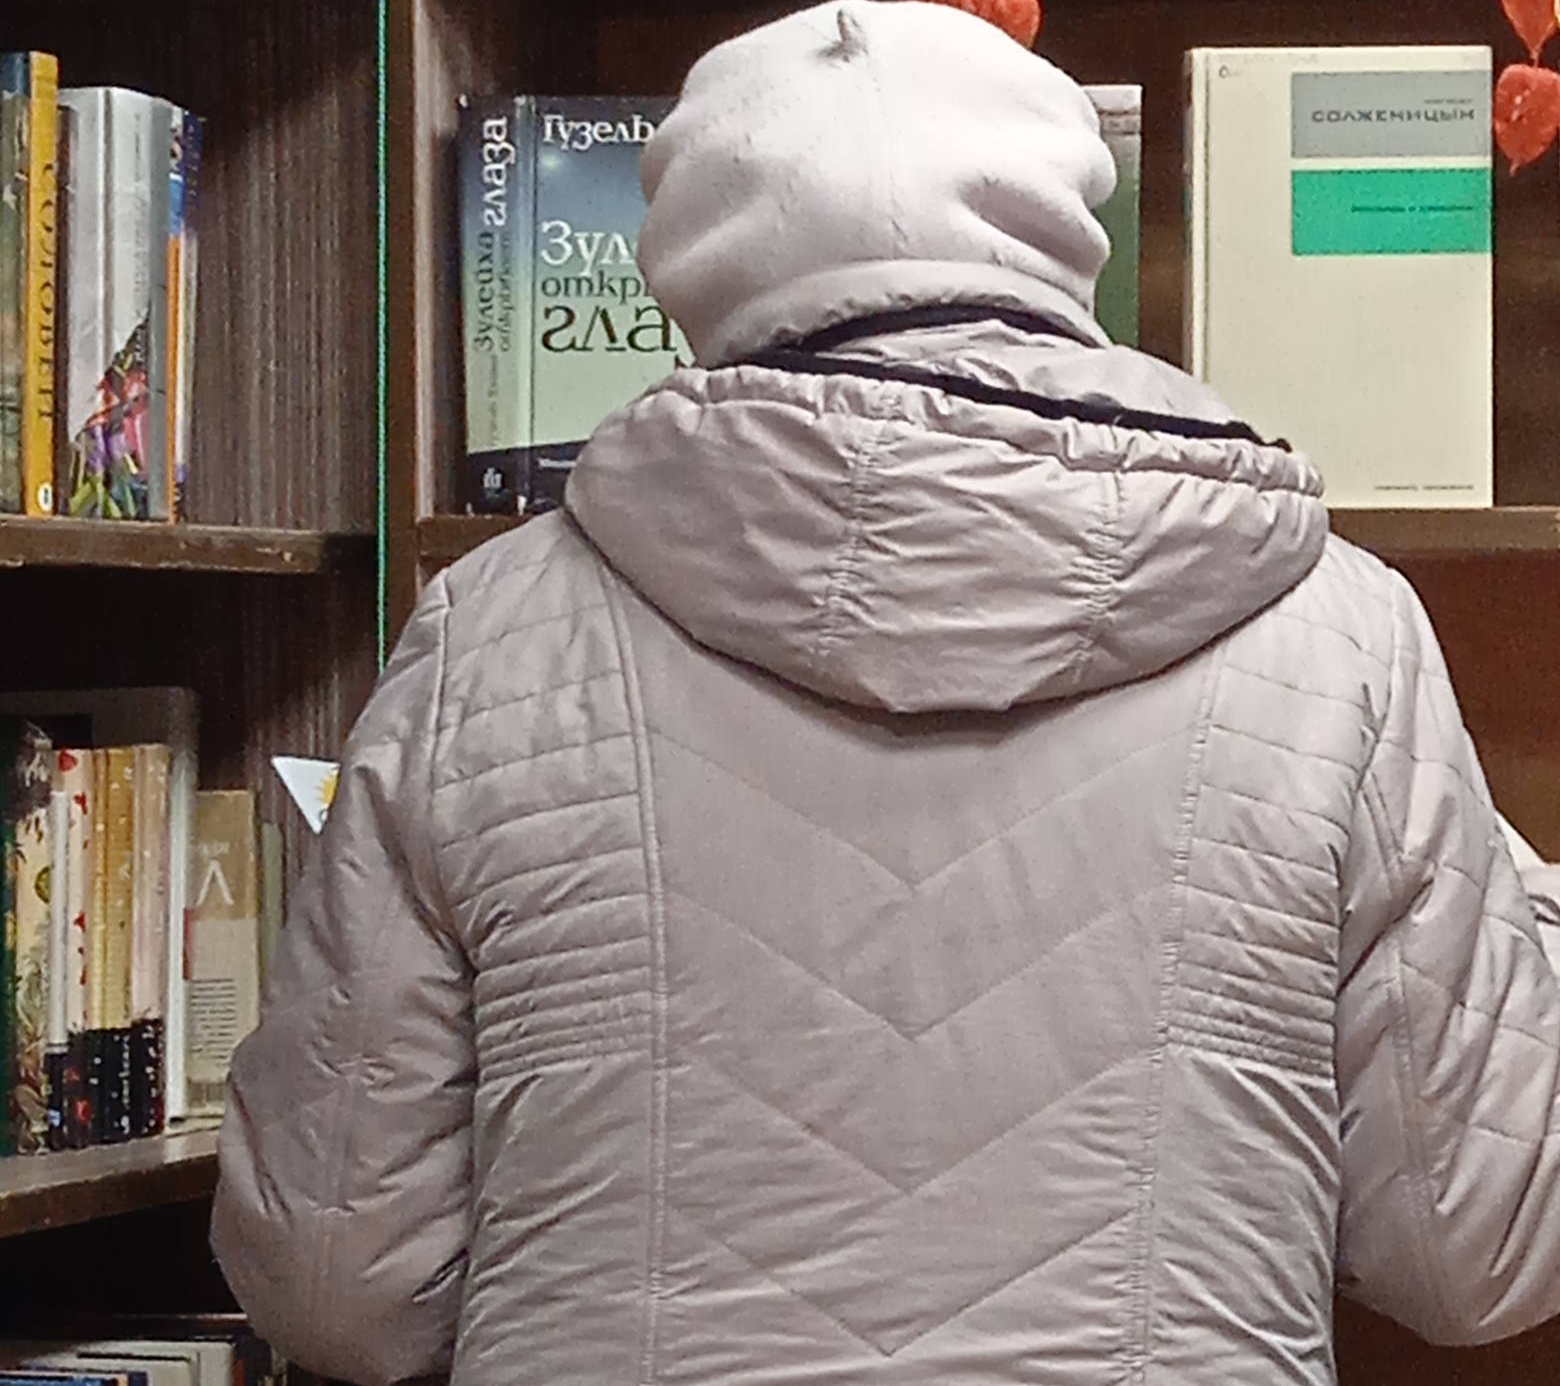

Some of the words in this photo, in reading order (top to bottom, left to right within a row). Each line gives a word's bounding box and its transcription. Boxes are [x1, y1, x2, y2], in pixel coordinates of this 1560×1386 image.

[541, 114, 659, 151] Гузель
[1311, 108, 1475, 123] СОЛЖЕНИЦЫН
[482, 116, 516, 227] глаза
[540, 220, 638, 277] Зул
[473, 231, 495, 353] Зулейха
[540, 305, 678, 353] гла
